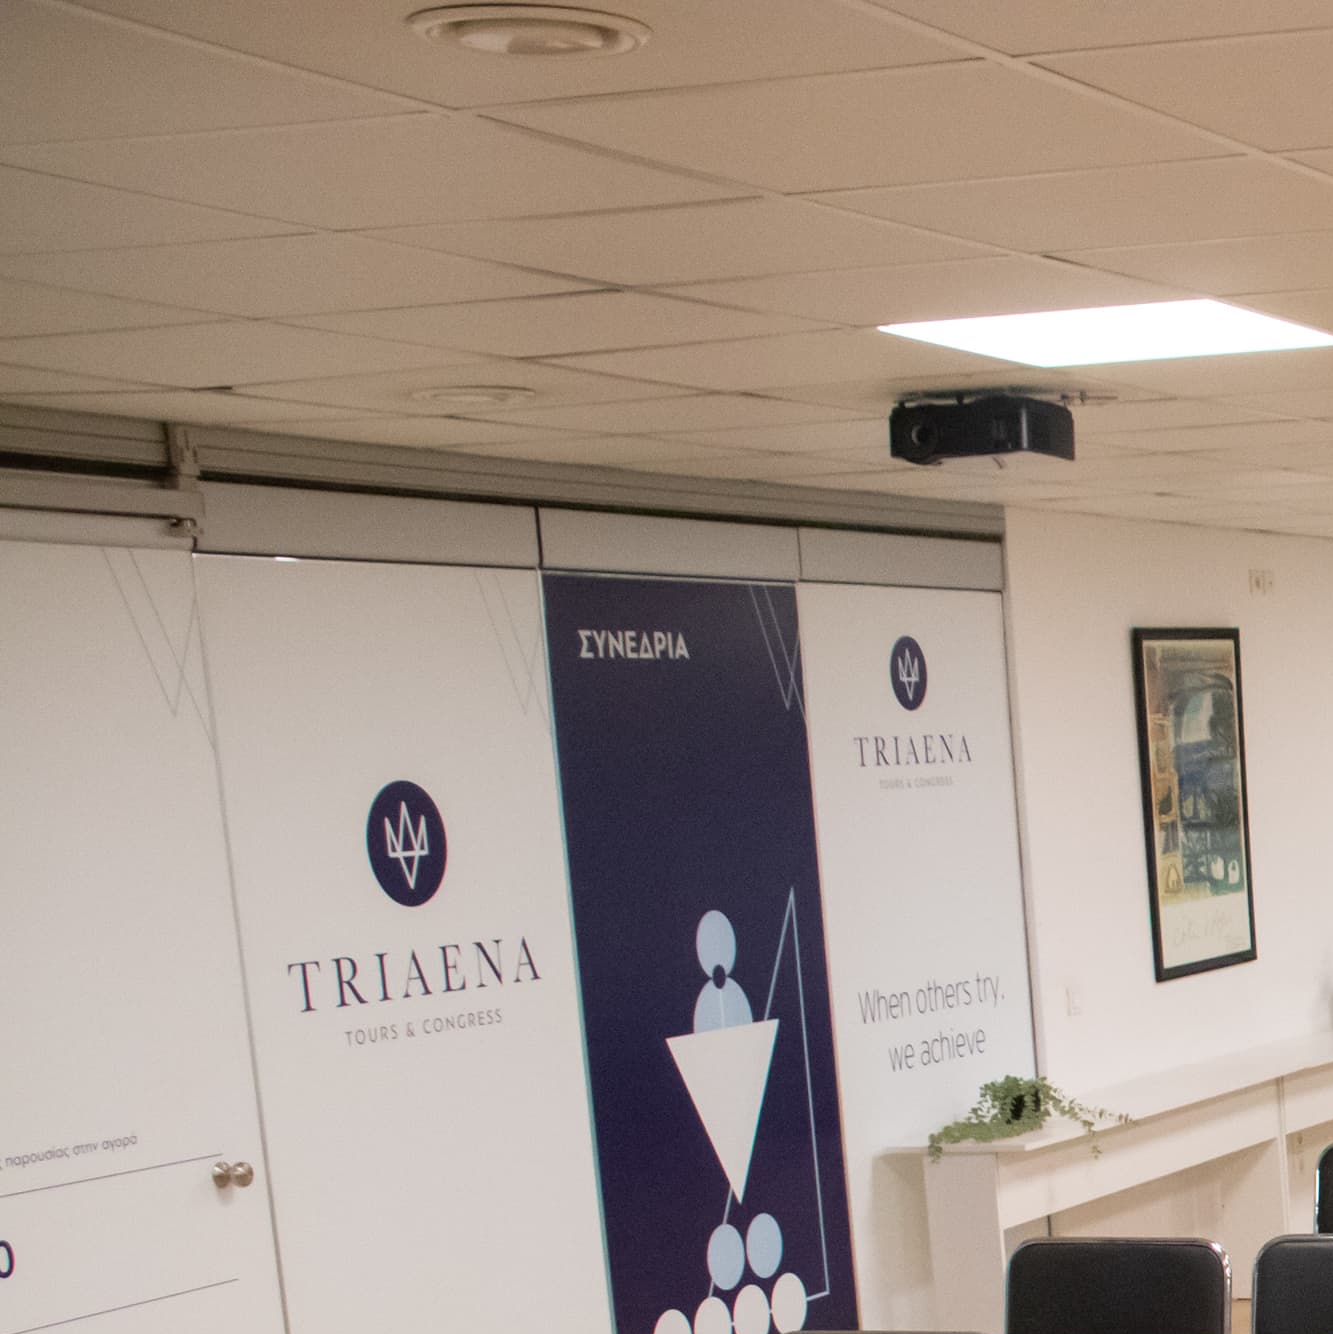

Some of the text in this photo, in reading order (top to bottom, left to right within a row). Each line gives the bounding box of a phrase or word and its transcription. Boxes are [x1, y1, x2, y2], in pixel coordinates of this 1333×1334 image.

[577, 629, 690, 660] ΣΥΝΕΔΡΙΑ
[853, 734, 972, 767] TRIAENA
[287, 936, 542, 1012] TRIAENA
[858, 989, 912, 1024] When
[916, 978, 972, 1014] others
[344, 1008, 503, 1047] TOURS & CONGRESS
[888, 1028, 986, 1072] we achieve
